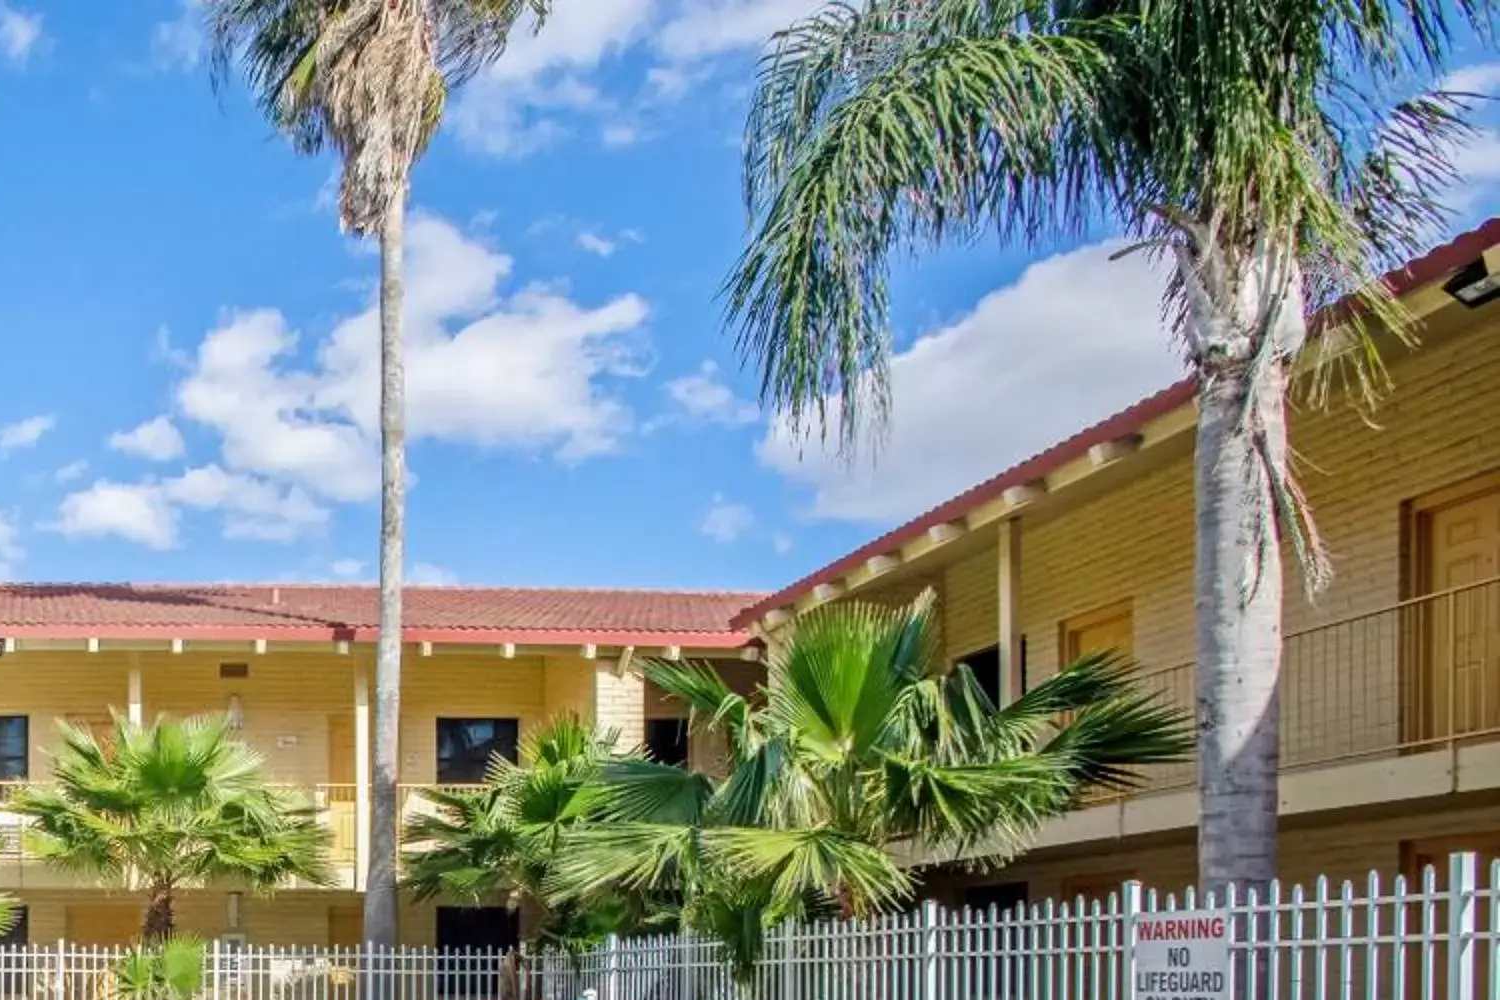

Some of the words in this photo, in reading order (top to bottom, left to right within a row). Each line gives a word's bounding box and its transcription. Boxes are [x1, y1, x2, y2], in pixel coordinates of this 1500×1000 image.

[1138, 918, 1224, 940] WARNING
[1167, 947, 1190, 967] NO
[1137, 971, 1223, 992] LIFEGUARD
